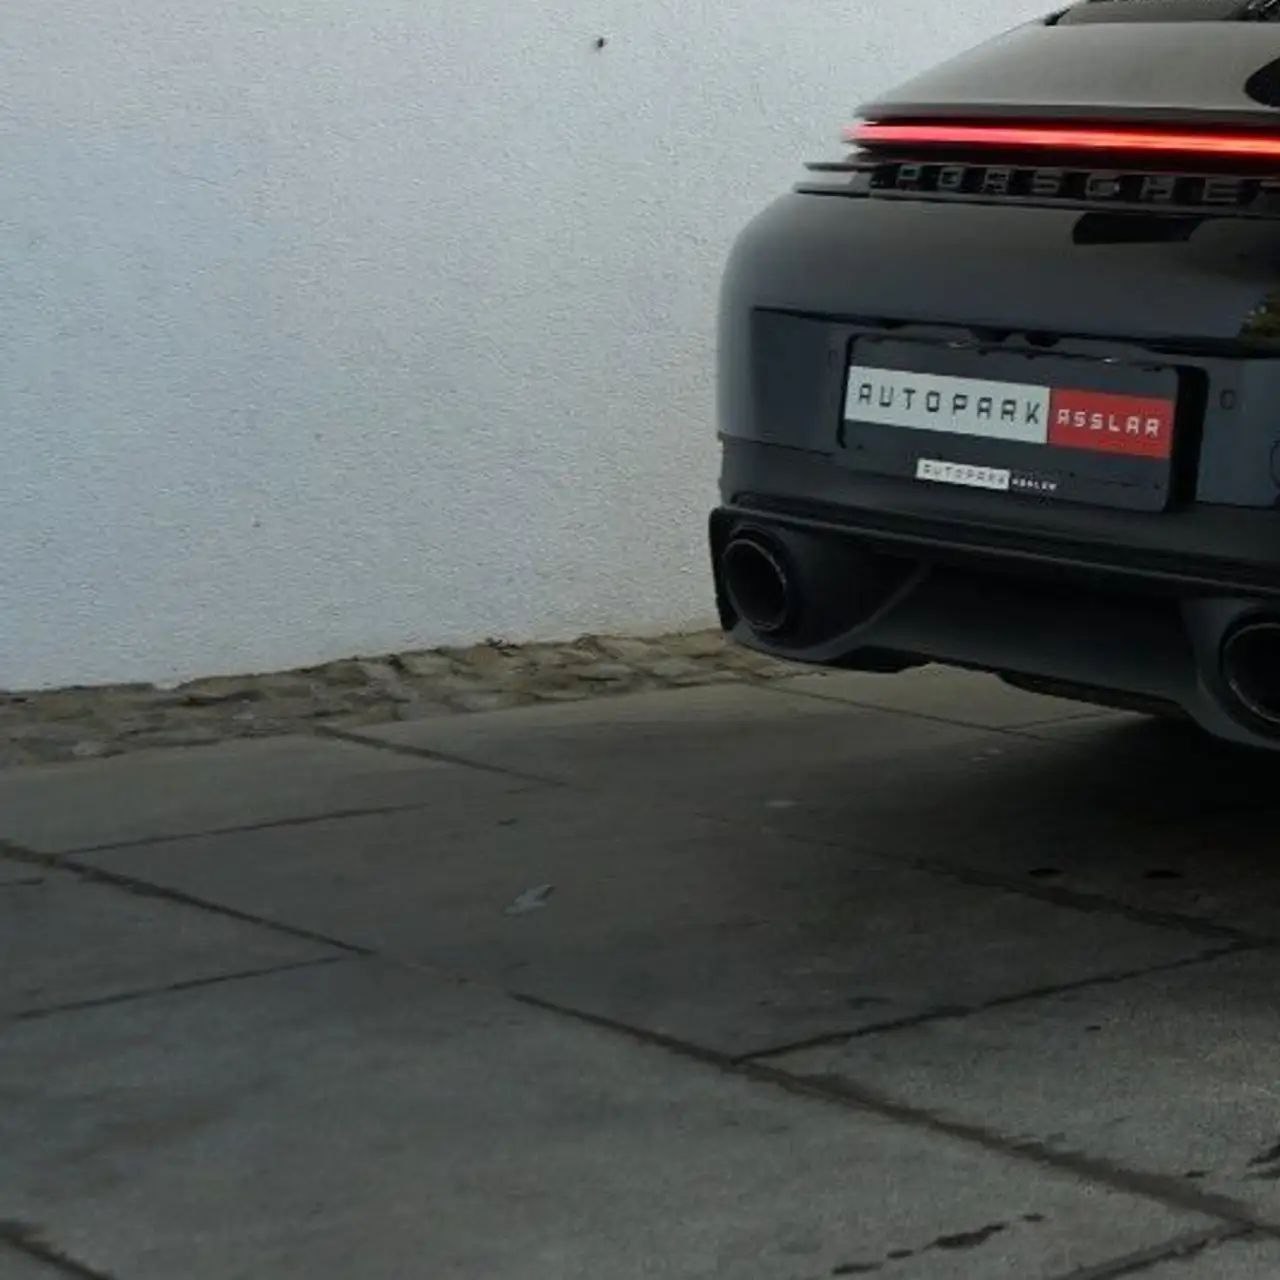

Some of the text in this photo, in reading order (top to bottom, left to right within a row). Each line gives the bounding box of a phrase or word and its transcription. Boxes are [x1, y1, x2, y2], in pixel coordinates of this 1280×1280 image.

[895, 163, 1240, 204] PORSCHE
[857, 383, 1159, 436] AUTOPARK ASSLAR
